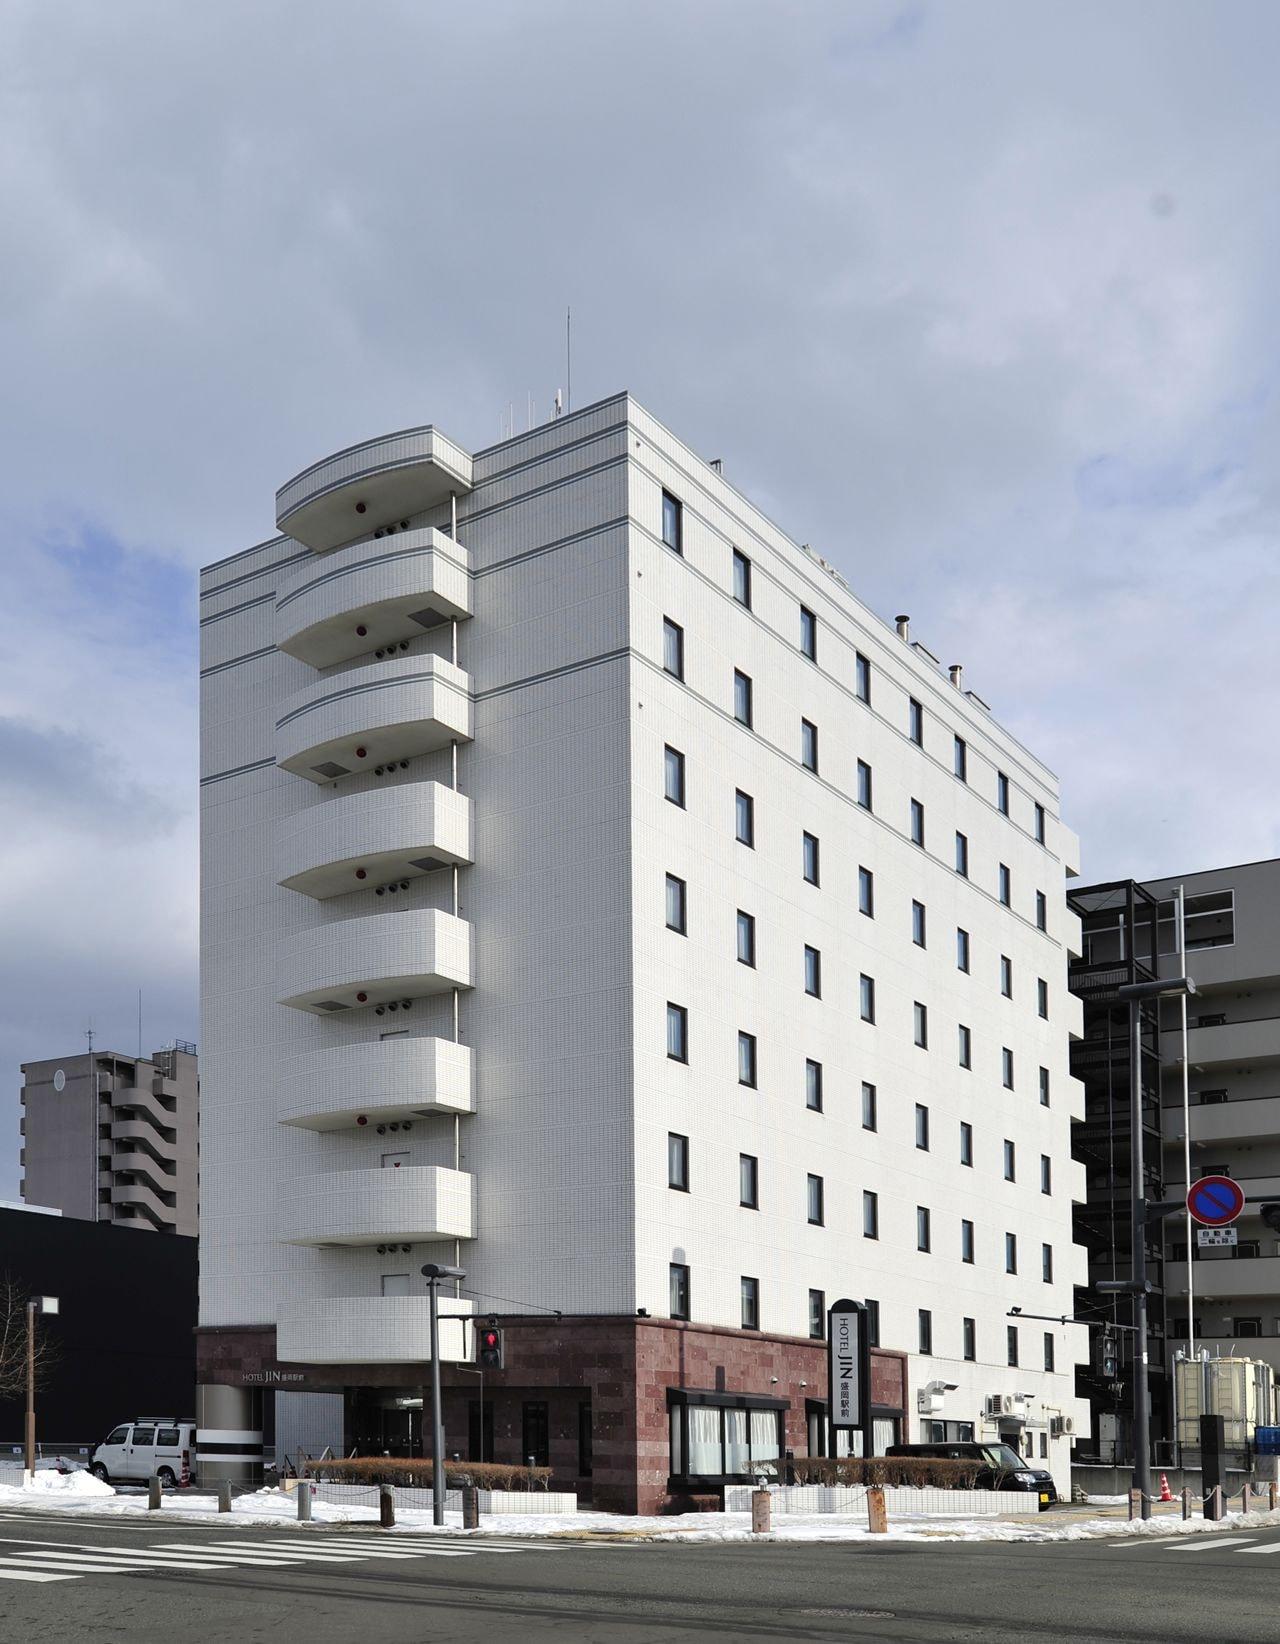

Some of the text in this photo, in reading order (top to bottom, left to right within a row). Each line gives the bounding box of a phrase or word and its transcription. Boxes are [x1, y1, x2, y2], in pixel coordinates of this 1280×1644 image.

[242, 1373, 263, 1381] HOTEL
[265, 1371, 280, 1383] JIN
[838, 1317, 853, 1418] HOTEL JIN 盛岡駅前
